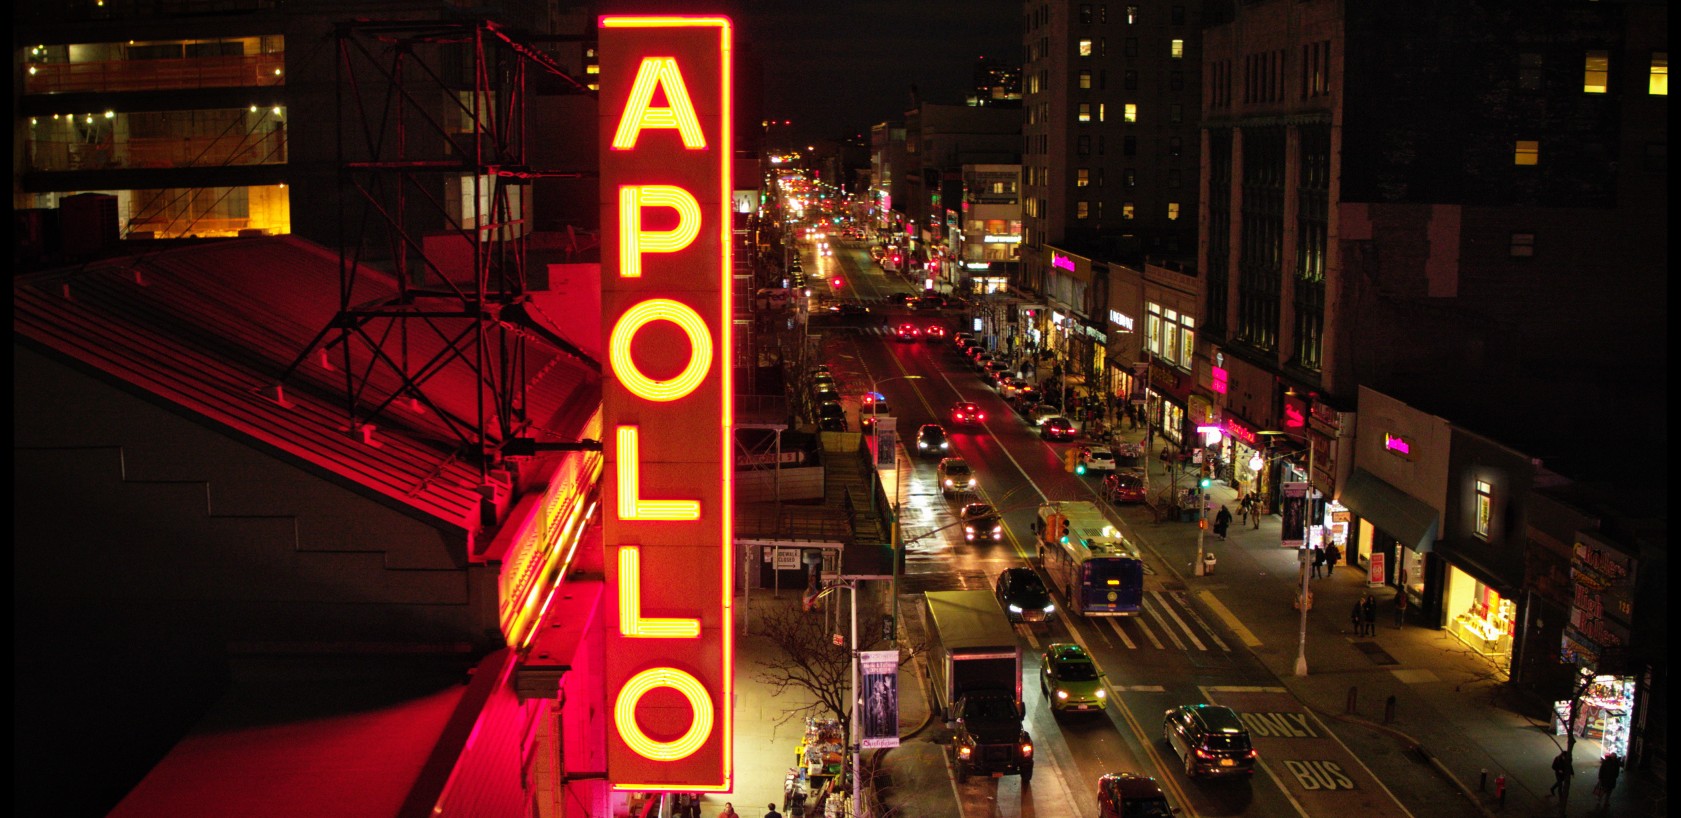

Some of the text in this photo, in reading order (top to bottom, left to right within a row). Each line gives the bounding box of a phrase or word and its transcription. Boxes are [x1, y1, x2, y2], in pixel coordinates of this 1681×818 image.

[609, 56, 713, 762] APOLLO
[1575, 584, 1603, 618] High
[1580, 612, 1623, 645] Rollers
[1241, 712, 1317, 737] ONLY
[1283, 760, 1353, 790] BUS
